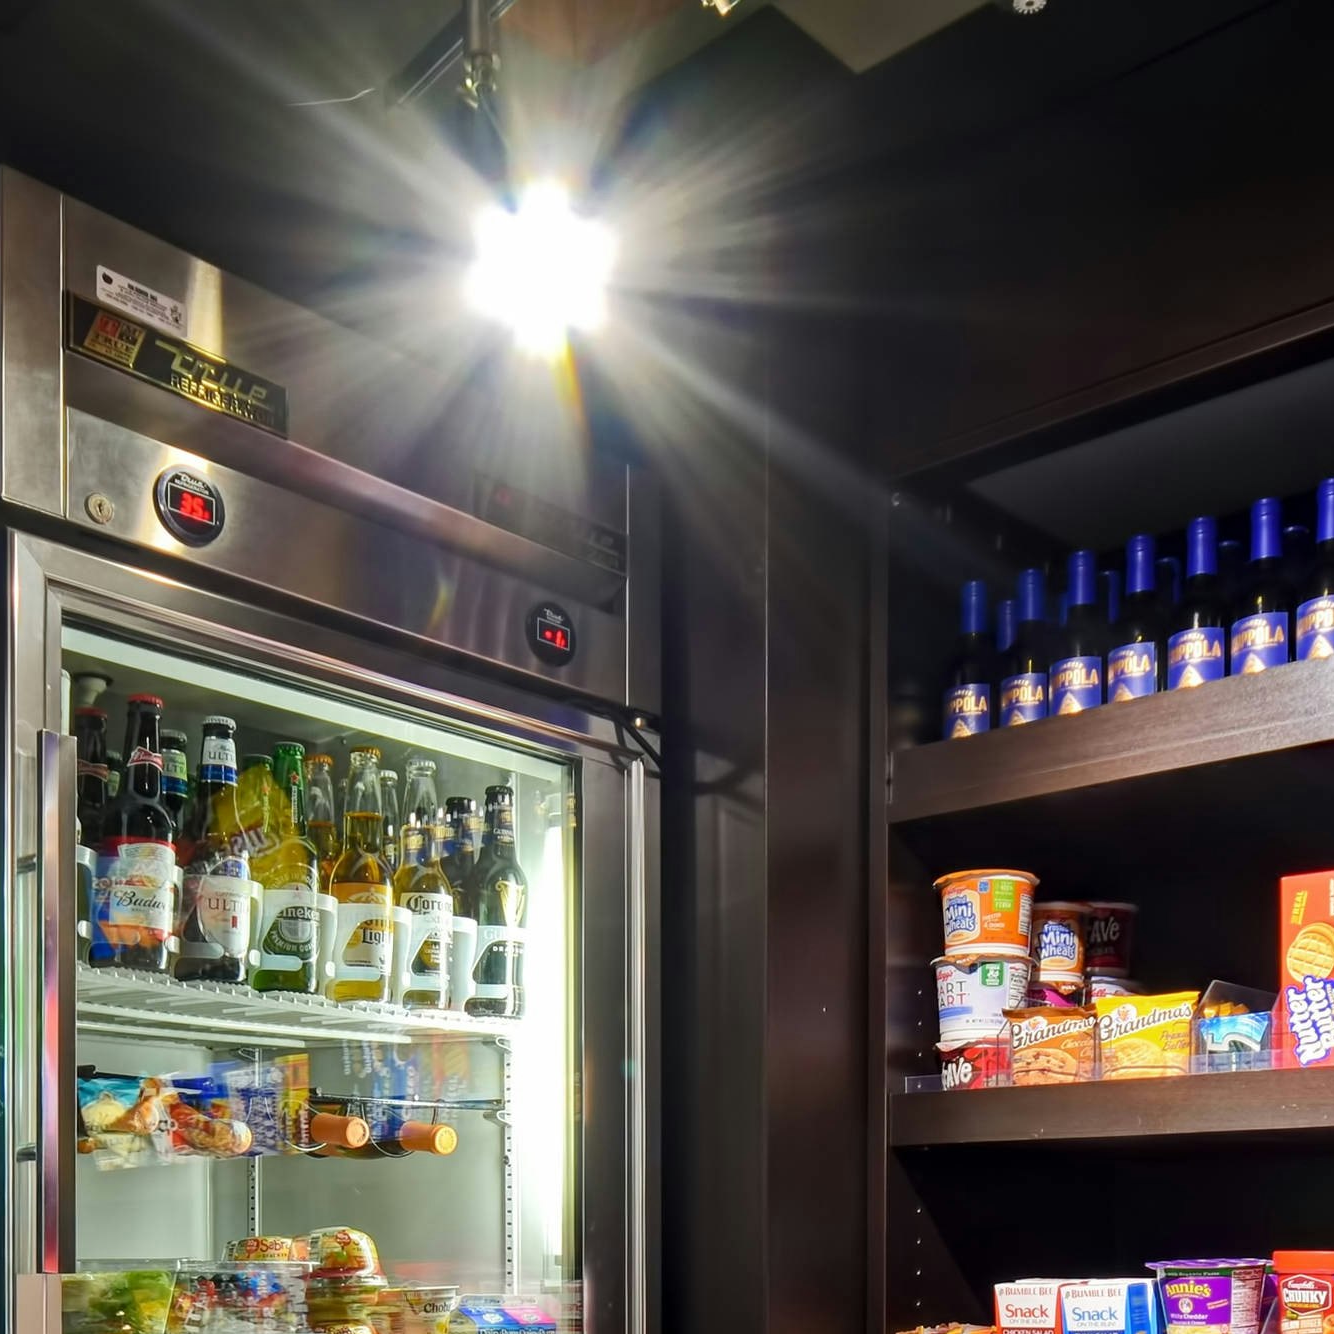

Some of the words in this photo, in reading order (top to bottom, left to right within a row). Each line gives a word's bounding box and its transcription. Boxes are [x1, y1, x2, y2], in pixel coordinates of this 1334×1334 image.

[945, 902, 974, 919] Mini
[1041, 929, 1075, 947] Mini
[1098, 1002, 1193, 1042] Grandma's
[1166, 1280, 1212, 1298] Annie's
[1282, 1287, 1328, 1305] CHUNKY
[1005, 1304, 1049, 1319] Snack
[1072, 1307, 1118, 1321] Snack
